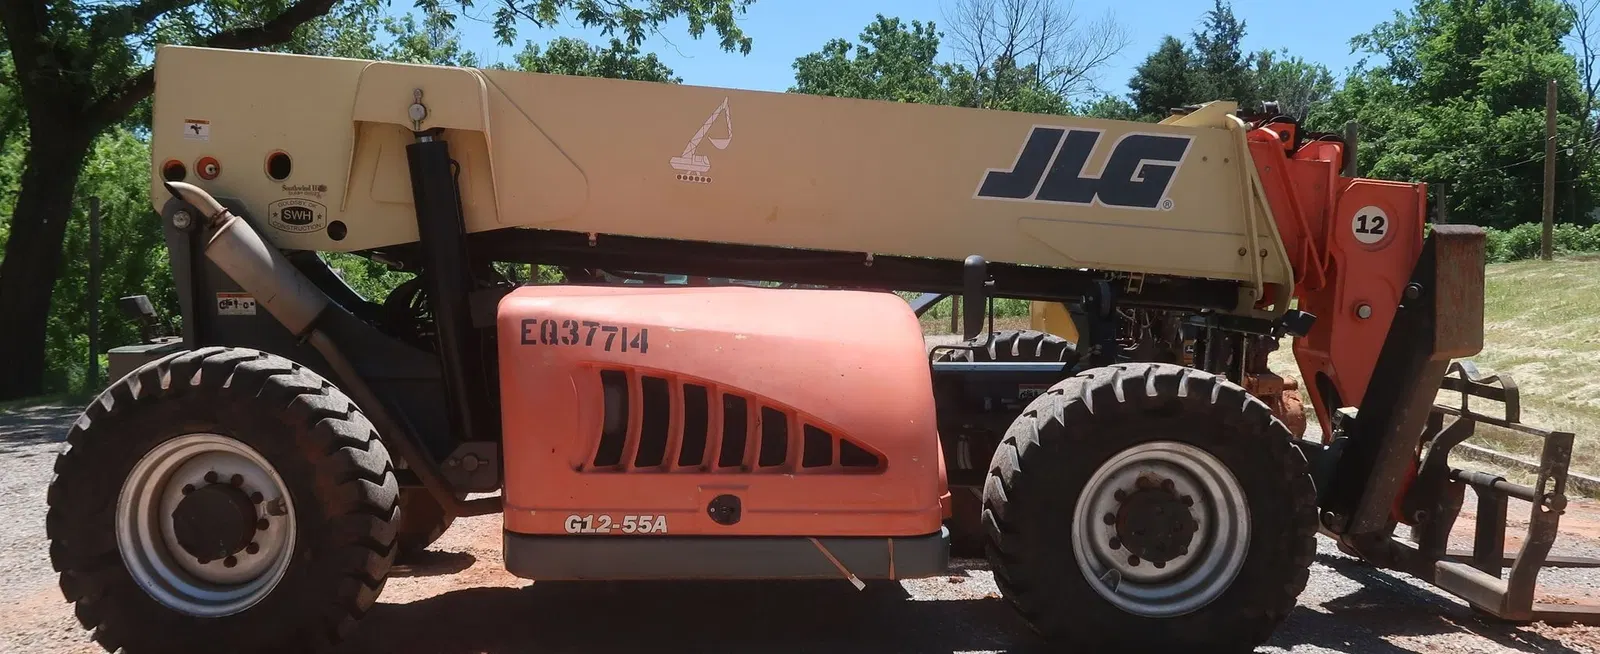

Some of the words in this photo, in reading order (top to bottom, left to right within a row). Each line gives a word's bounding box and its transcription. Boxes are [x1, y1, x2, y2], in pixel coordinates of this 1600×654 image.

[973, 125, 1195, 210] JLG
[283, 210, 311, 221] SWH
[1356, 215, 1385, 235] 12
[272, 221, 322, 231] CONSTRUCTION
[521, 319, 648, 354] EQ37714
[564, 514, 668, 534] G12-55A
